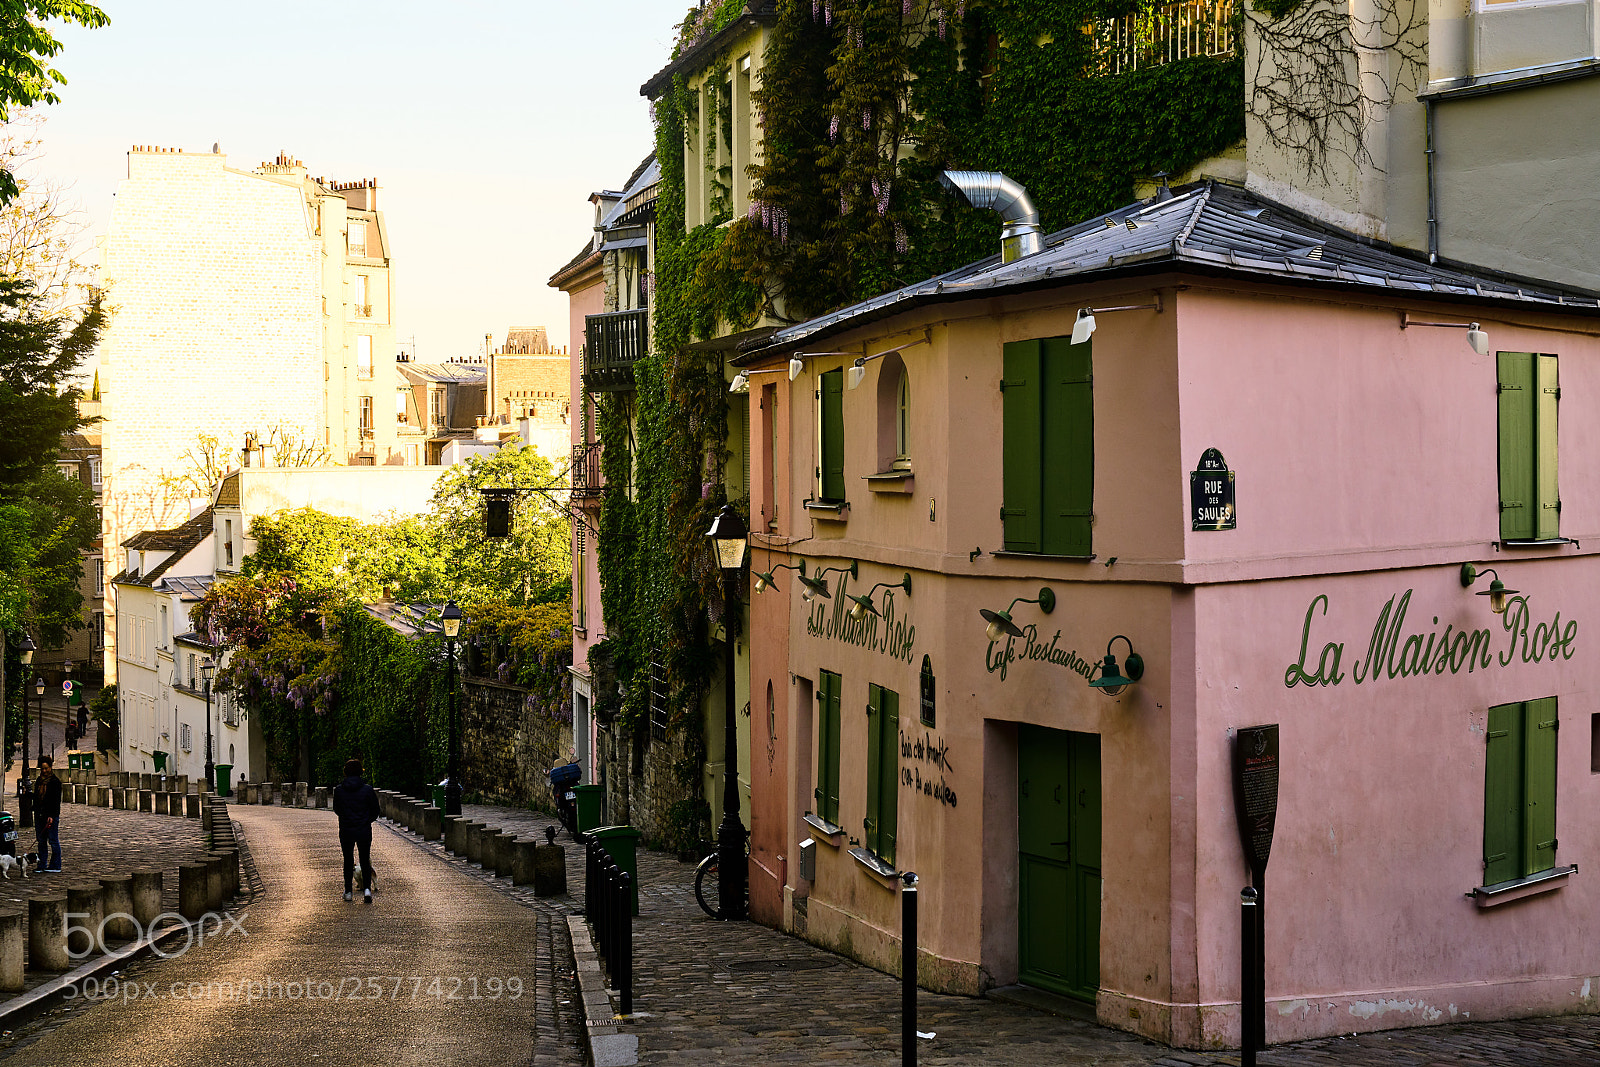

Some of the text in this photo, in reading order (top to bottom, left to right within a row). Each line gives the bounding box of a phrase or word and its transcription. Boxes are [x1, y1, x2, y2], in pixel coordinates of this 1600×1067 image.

[1204, 480, 1223, 494] RUE
[1208, 497, 1219, 505] DES
[1198, 506, 1231, 521] SAULES
[827, 571, 878, 651] Maison
[880, 589, 916, 665] Rose
[986, 624, 1104, 684] Café Restaurant
[1284, 588, 1578, 688] La Maison Rose
